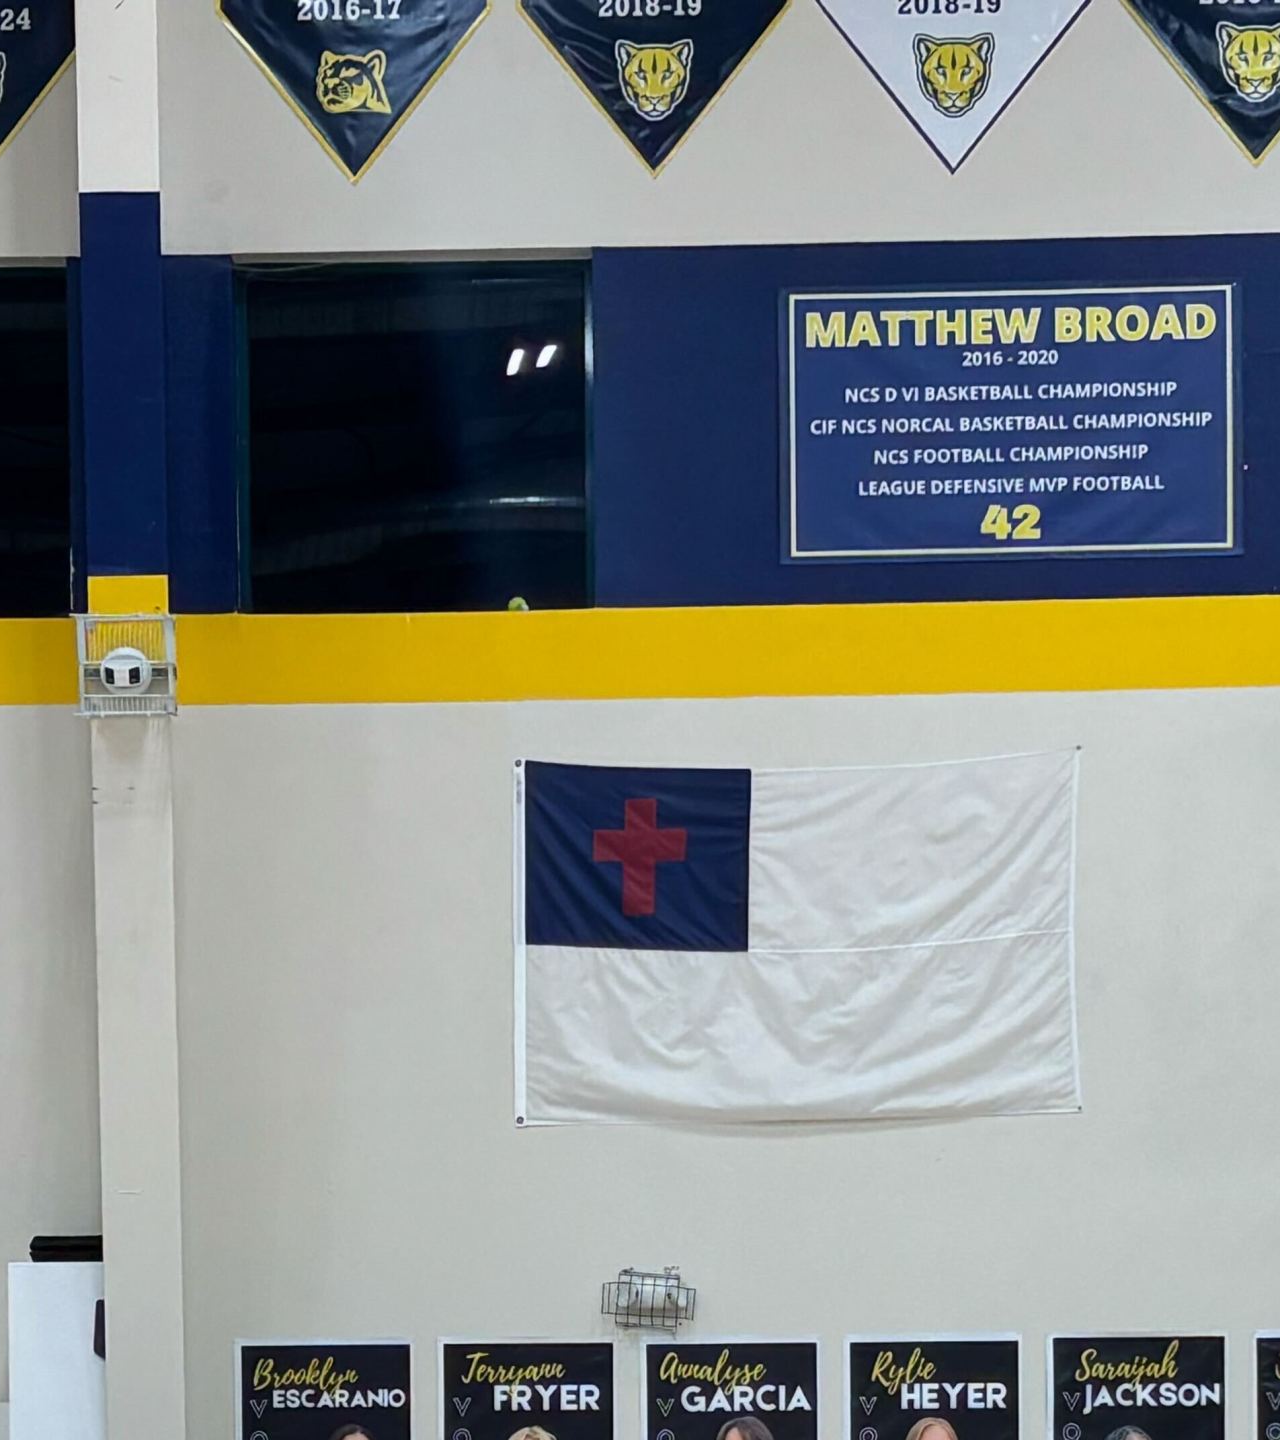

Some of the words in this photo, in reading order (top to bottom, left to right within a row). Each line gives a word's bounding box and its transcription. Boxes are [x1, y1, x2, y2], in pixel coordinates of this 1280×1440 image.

[297, 0, 400, 20] 2016-17
[599, 0, 701, 16] 2018-19
[806, 309, 1039, 347] MATTHEW
[1056, 304, 1216, 342] BROAD
[963, 351, 1002, 366] 2016
[1018, 350, 1058, 364] 2020
[846, 388, 879, 402] NCS
[885, 388, 897, 402] D
[902, 388, 918, 401] VI
[925, 385, 1032, 401] BASKETBALL
[1038, 382, 1177, 398] CHAMPIONSHIP
[811, 420, 836, 434] CIF
[842, 419, 876, 434] NCS
[882, 418, 953, 433] NORCAL
[960, 416, 1068, 431] BASKETBALL
[1073, 412, 1212, 429] CHAMPIONSHIP
[875, 450, 908, 464] NCS
[914, 448, 1004, 463] FOOTBALL
[1010, 445, 1148, 461] CHAMPIONSHIP
[859, 481, 925, 495] LEAGUE
[931, 479, 1023, 494] DEFENSIVE
[1030, 477, 1067, 492] MVP
[1073, 475, 1164, 491] FOOTBALL
[982, 505, 1040, 539] 42
[254, 1358, 357, 1394] Brooklyn
[464, 1351, 563, 1397] Terryann
[659, 1352, 764, 1392] Annalyse
[870, 1350, 935, 1392] Rylie
[494, 1384, 599, 1410] FRYER
[681, 1384, 811, 1412] GARCIA
[900, 1383, 1006, 1409] HEYER
[1083, 1382, 1220, 1414] JACKSON
